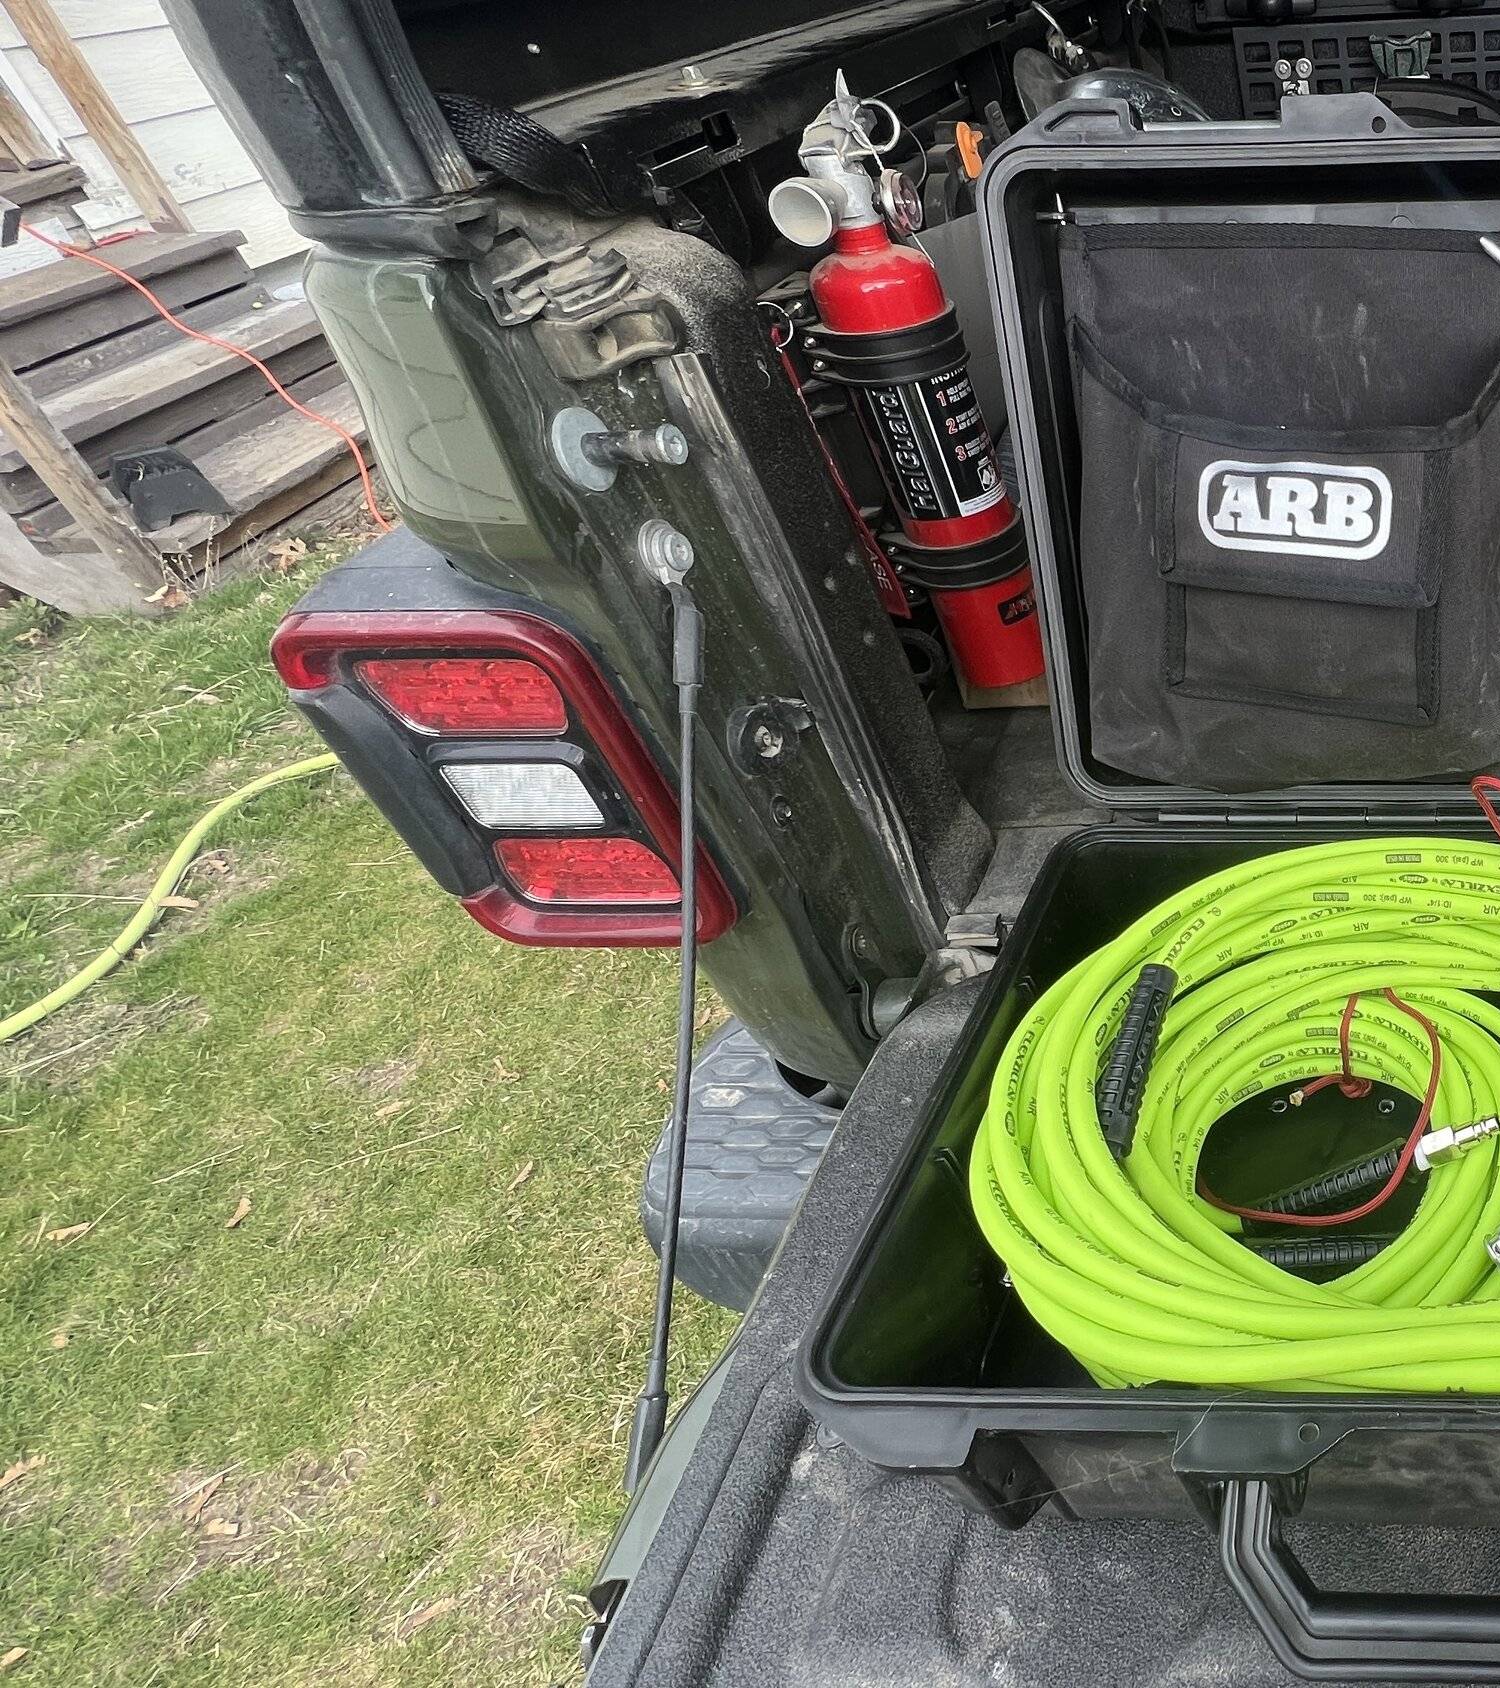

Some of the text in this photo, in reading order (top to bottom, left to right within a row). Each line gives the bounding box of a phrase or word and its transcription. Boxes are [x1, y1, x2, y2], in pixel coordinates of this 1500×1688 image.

[936, 391, 947, 406] 1
[945, 418, 958, 434] 2
[955, 446, 966, 461] 3
[1213, 474, 1374, 542] ARB
[1483, 904, 1500, 915] AIR
[1354, 921, 1369, 931] AIR
[1216, 947, 1233, 962] AIR
[1381, 1070, 1396, 1082] AIR
[1216, 1087, 1230, 1104] AIR
